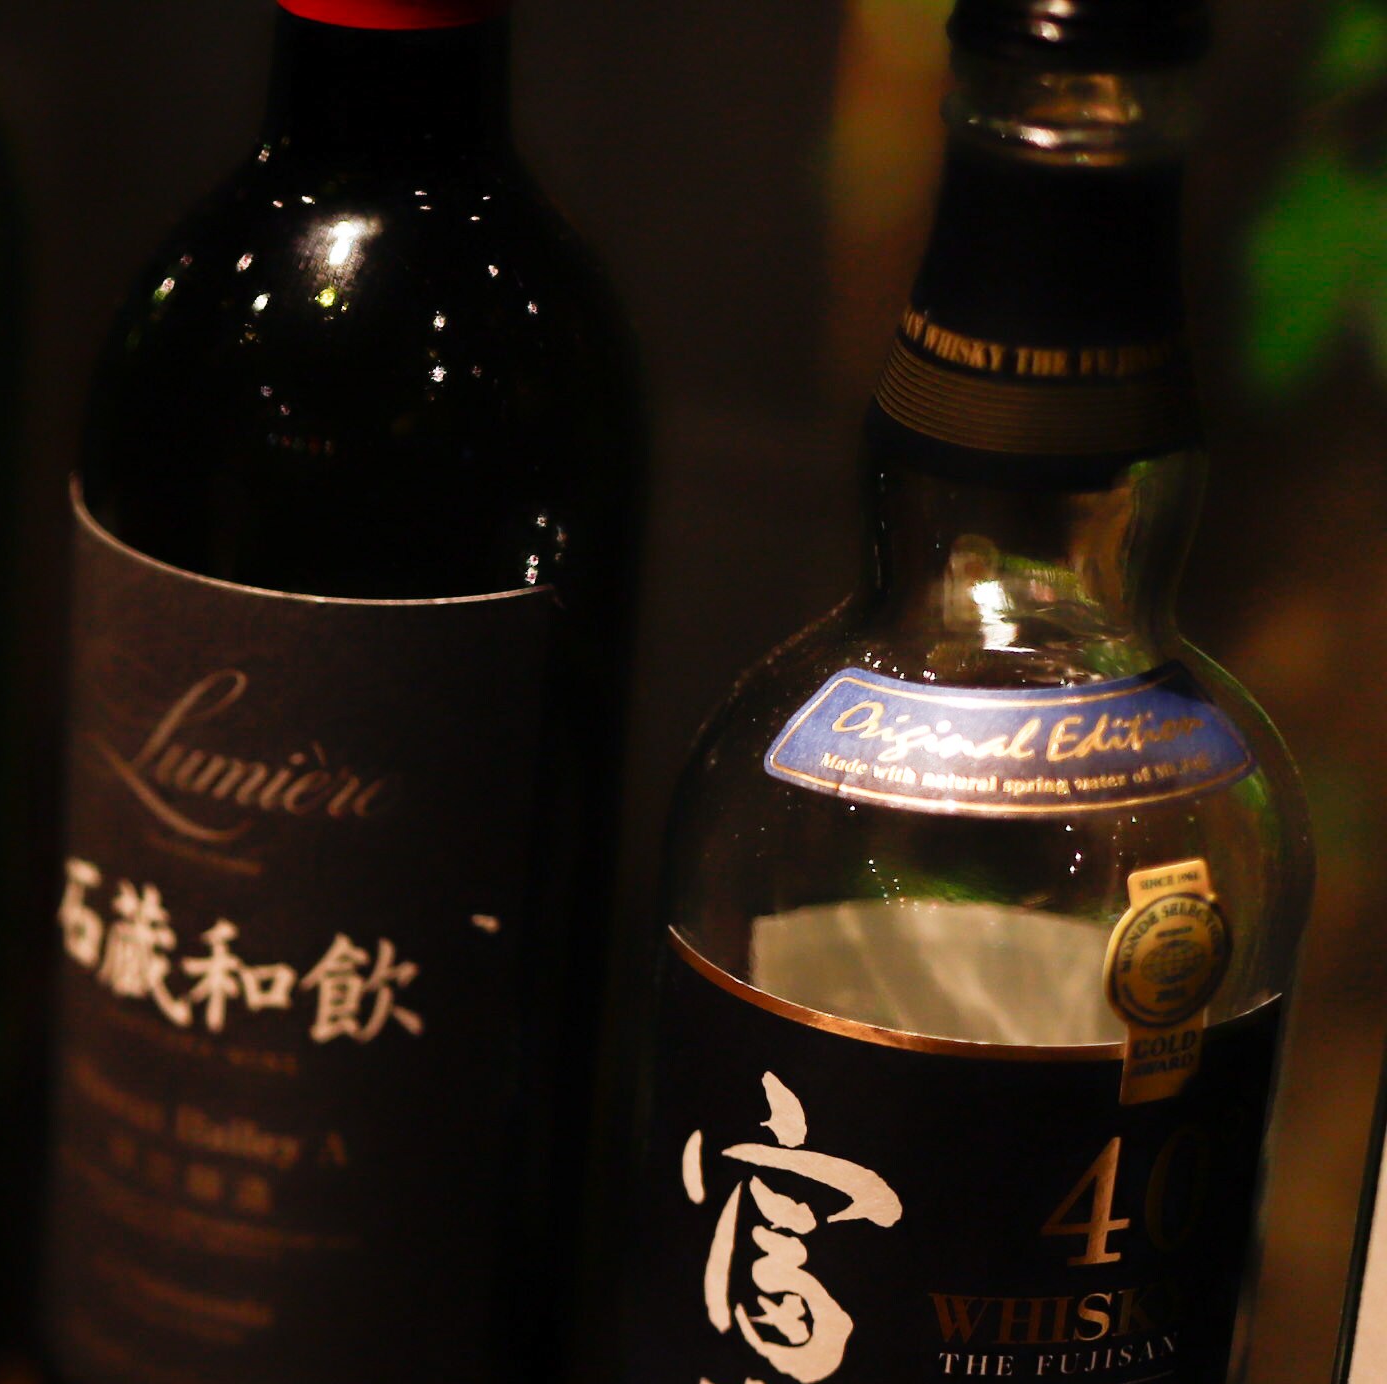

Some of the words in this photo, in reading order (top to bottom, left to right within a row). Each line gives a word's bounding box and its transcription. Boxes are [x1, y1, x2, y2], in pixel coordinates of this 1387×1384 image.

[832, 700, 1041, 763] Original
[1045, 712, 1204, 763] Edition
[820, 751, 870, 776] Made
[873, 765, 917, 785] with
[921, 771, 999, 792] natural
[1002, 775, 1070, 796] spring
[1074, 775, 1128, 792] water
[1131, 1030, 1197, 1060] GOLD
[938, 1352, 1015, 1377] THE
[1034, 1330, 1180, 1377] FUJISAN
